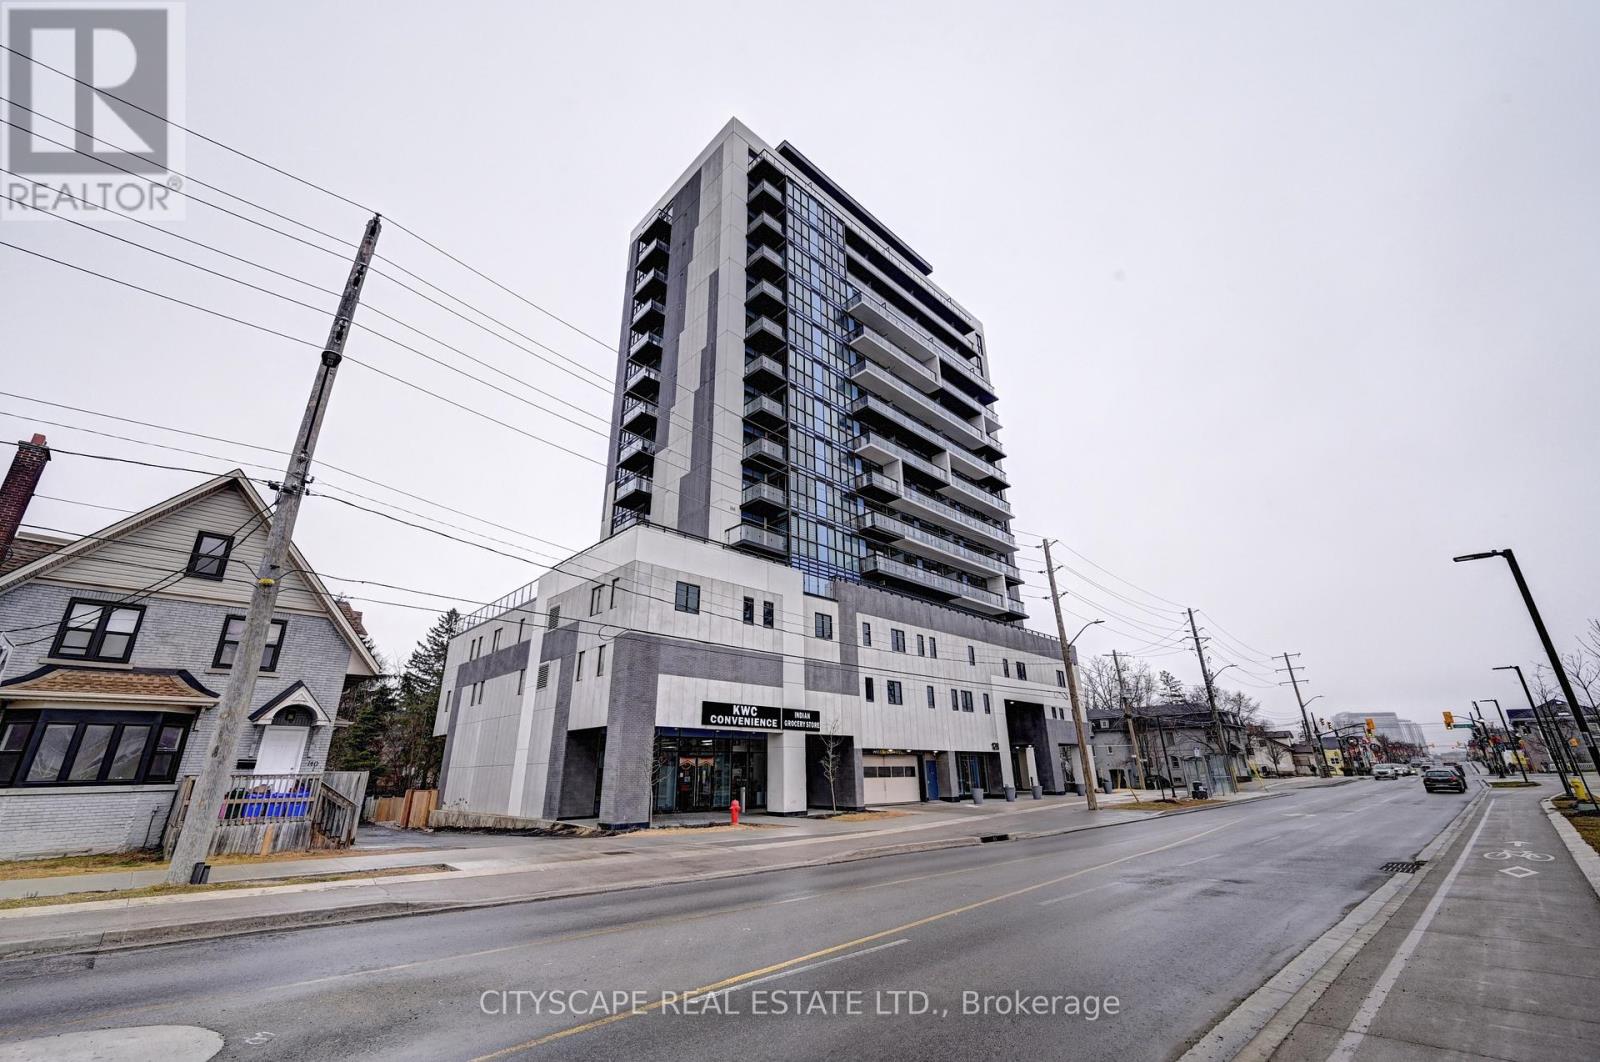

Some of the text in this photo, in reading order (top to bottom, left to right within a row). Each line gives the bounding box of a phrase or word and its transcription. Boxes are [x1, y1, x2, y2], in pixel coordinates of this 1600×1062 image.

[732, 704, 758, 717] KWC
[794, 711, 811, 720] INDIAN
[710, 714, 778, 728] CONVENIENCE
[784, 719, 820, 729] GROCERY STORE
